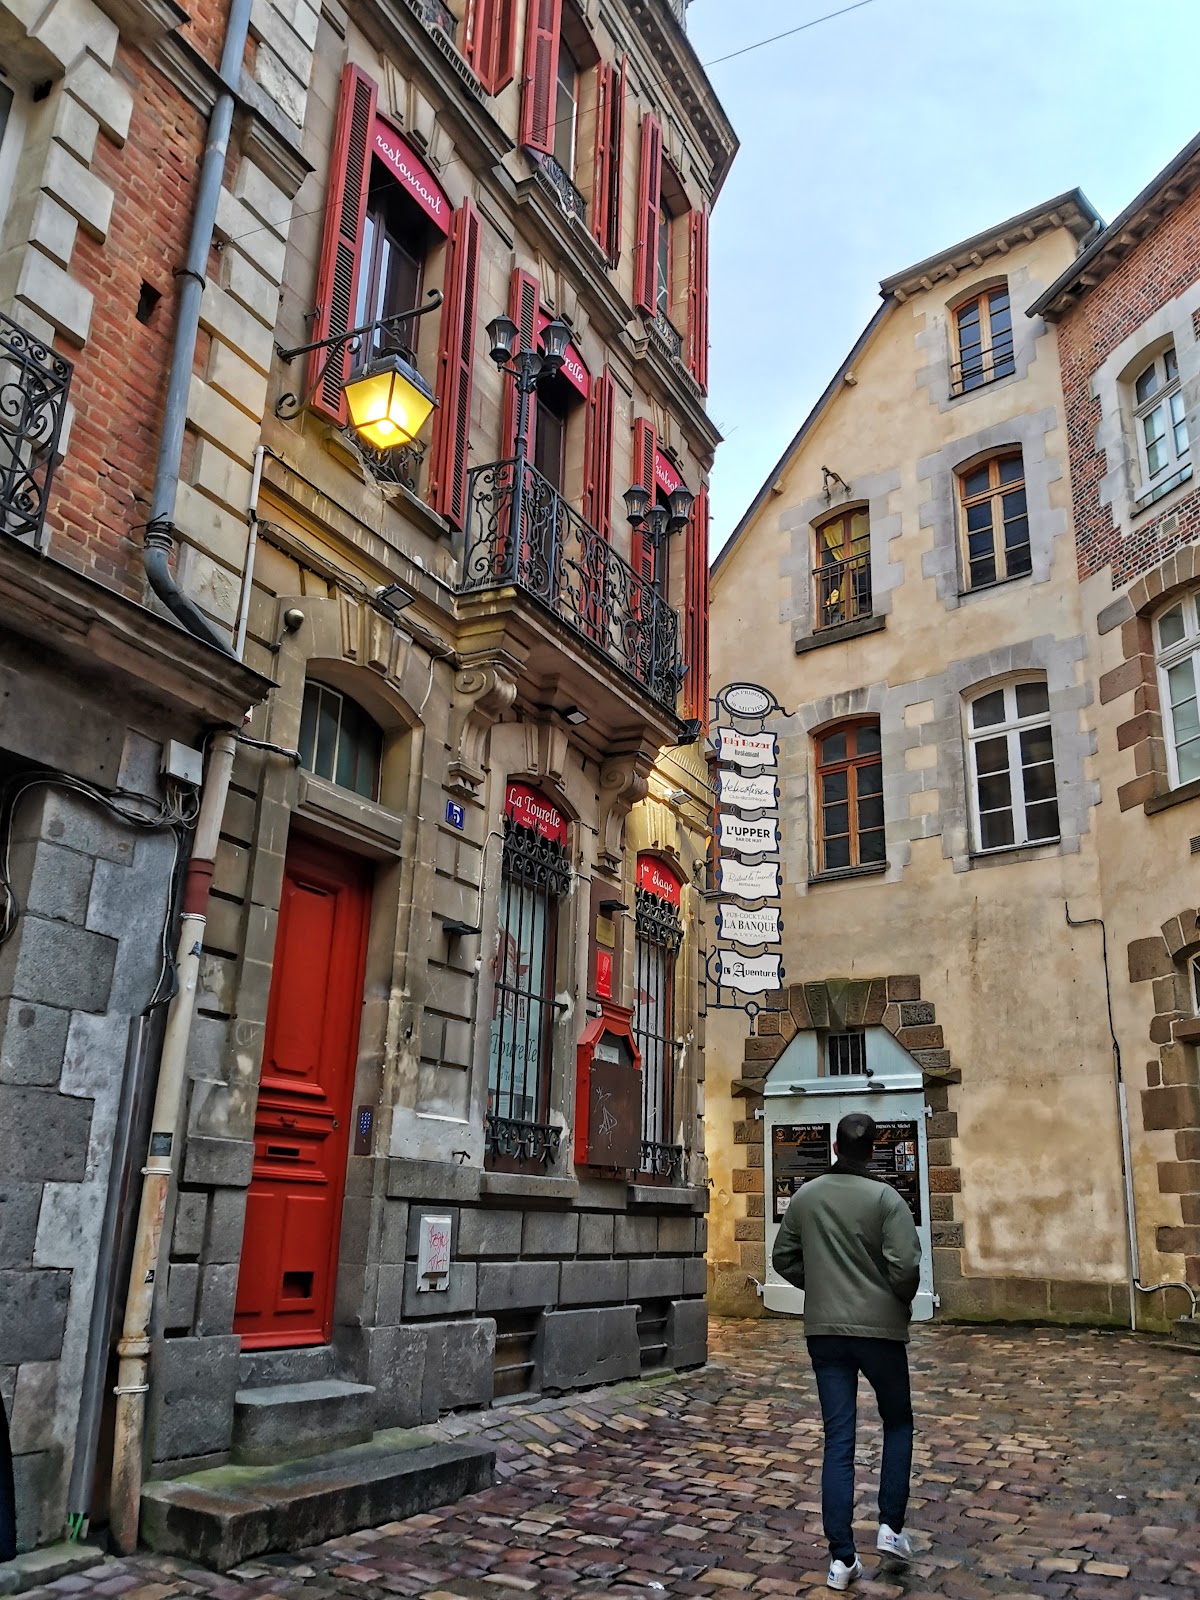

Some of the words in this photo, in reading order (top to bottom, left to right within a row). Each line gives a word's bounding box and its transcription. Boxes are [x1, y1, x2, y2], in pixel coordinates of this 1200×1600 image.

[375, 134, 442, 214] restaurant
[563, 355, 585, 383] relle
[723, 737, 739, 747] Big
[741, 739, 770, 750] Bazar
[453, 804, 462, 824] 5
[508, 788, 522, 808] La
[524, 796, 561, 828] Tourelle
[726, 826, 771, 839] L'UPPER
[652, 870, 674, 898] étage
[724, 919, 737, 929] LA
[738, 920, 778, 933] BANQUE
[491, 1033, 538, 1063] Touele
